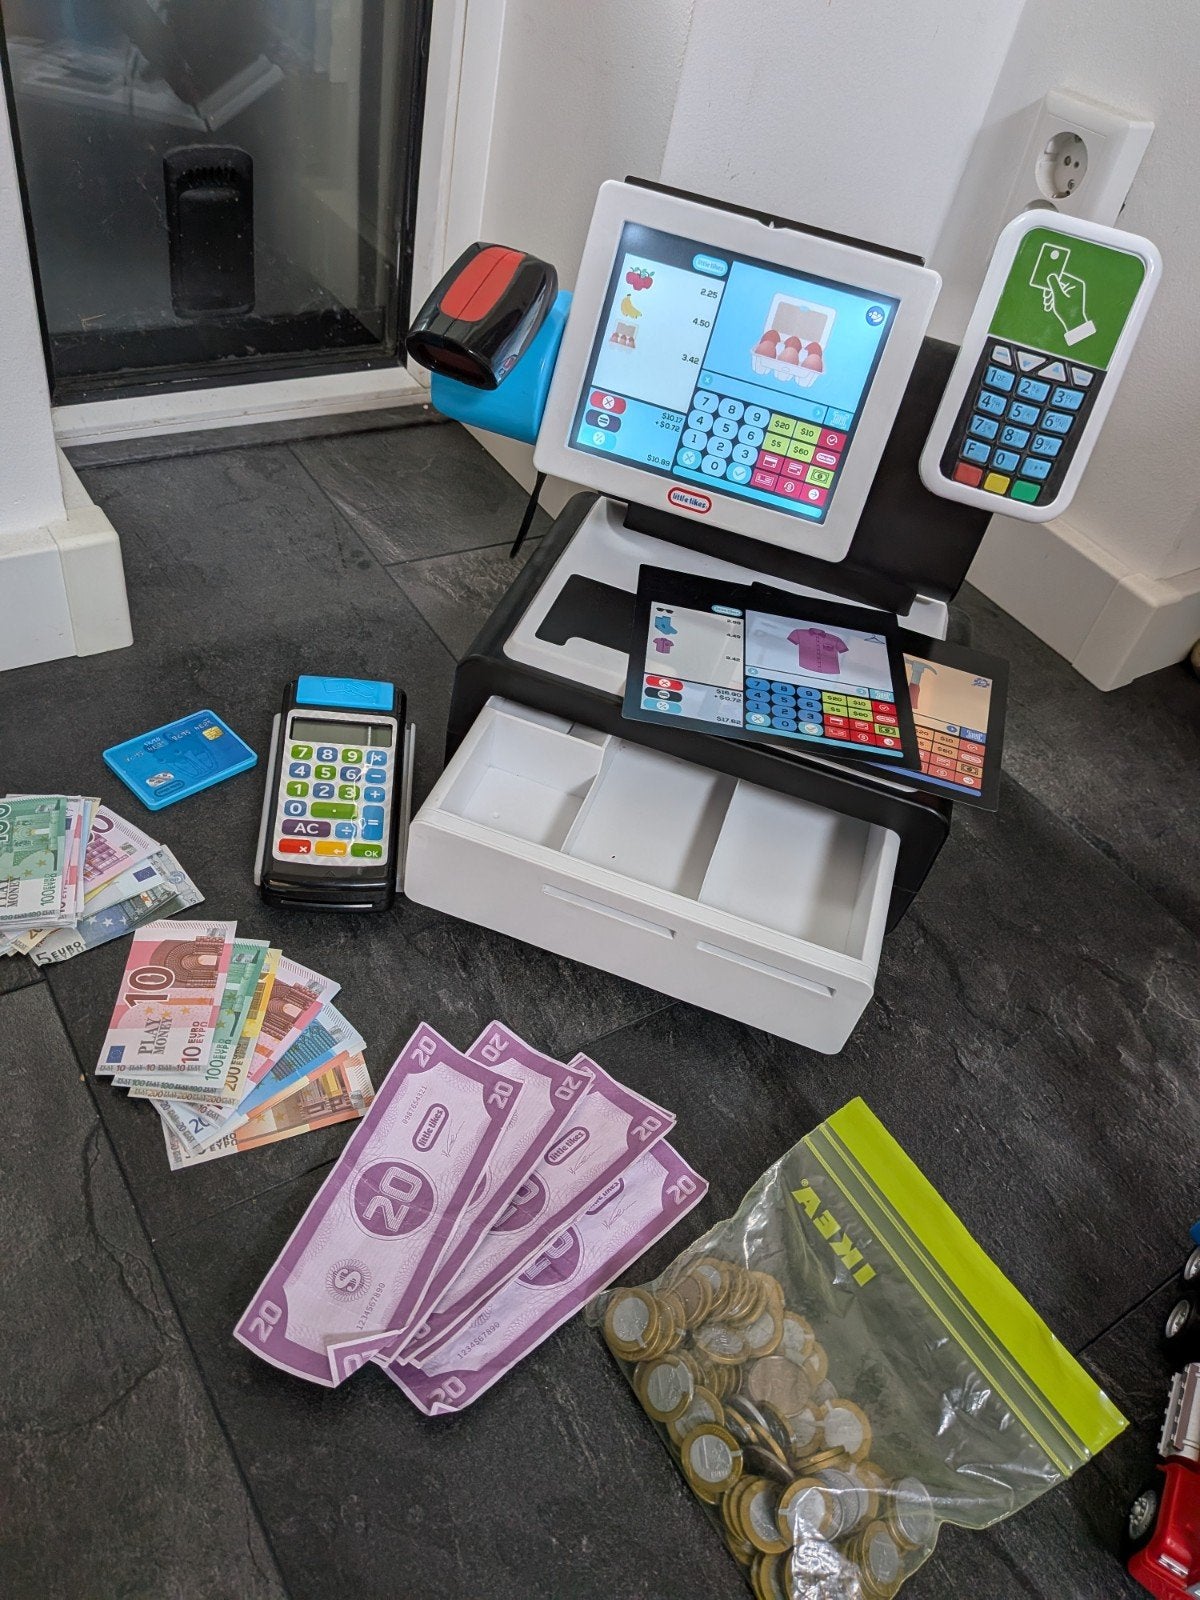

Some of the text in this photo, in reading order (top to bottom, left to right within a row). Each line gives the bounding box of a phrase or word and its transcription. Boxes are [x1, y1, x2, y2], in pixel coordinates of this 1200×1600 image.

[700, 288, 718, 299] 2.25
[692, 318, 710, 328] 4.50
[681, 354, 700, 364] 3.42
[990, 368, 996, 382] 1
[1020, 380, 1031, 394] 2
[702, 396, 710, 406] 7
[981, 394, 991, 408] 4
[1054, 390, 1064, 404] 3
[728, 404, 736, 414] 8
[1012, 406, 1023, 418] 5
[662, 412, 683, 424] $10.17
[696, 416, 704, 426] 4
[752, 412, 760, 422] 9
[1044, 415, 1054, 428] 6
[722, 423, 730, 433] 5
[774, 420, 790, 430] $20
[974, 418, 984, 430] 7
[690, 434, 698, 444] 1
[747, 431, 755, 440] 6
[800, 427, 814, 438] $10
[1004, 429, 1014, 442] 8
[716, 442, 725, 452] 2
[771, 438, 782, 448] $5
[966, 442, 976, 455] F
[1035, 438, 1044, 450] 9
[741, 450, 750, 460] 3
[793, 446, 810, 456] $60
[646, 454, 671, 467] $10.89
[710, 461, 719, 471] 0
[995, 453, 1005, 466] 0
[298, 747, 308, 758] 7
[322, 749, 333, 760] 8
[347, 750, 357, 762] 9
[294, 765, 306, 776] 4
[320, 767, 331, 778] 5
[346, 769, 356, 780] 6
[294, 784, 302, 794] 1
[318, 786, 330, 797] 2
[344, 786, 356, 798] 3
[290, 802, 302, 815] 0
[294, 822, 320, 835] AC
[364, 850, 379, 858] OK
[40, 889, 56, 906] 100
[35, 952, 52, 966] 5
[50, 941, 82, 961] EURO
[124, 966, 176, 1008] 10
[138, 1018, 162, 1056] PLAY
[152, 1016, 173, 1055] MONEY
[188, 1021, 200, 1044] EURO
[410, 1036, 438, 1068] 20
[481, 1032, 510, 1062] 20
[180, 1046, 202, 1064] 10
[204, 1038, 224, 1081] 100 EURO
[224, 1066, 242, 1092] 200
[554, 1076, 582, 1100] 20
[486, 1080, 514, 1110] 20
[418, 1109, 444, 1147] little tikes
[631, 1114, 663, 1142] 20
[548, 1132, 585, 1161] little tikes
[666, 1174, 697, 1205] 20
[362, 1165, 424, 1233] 20
[356, 1282, 386, 1330] 1234567890
[250, 1300, 282, 1343] 20
[456, 1321, 500, 1360] 1234567890
